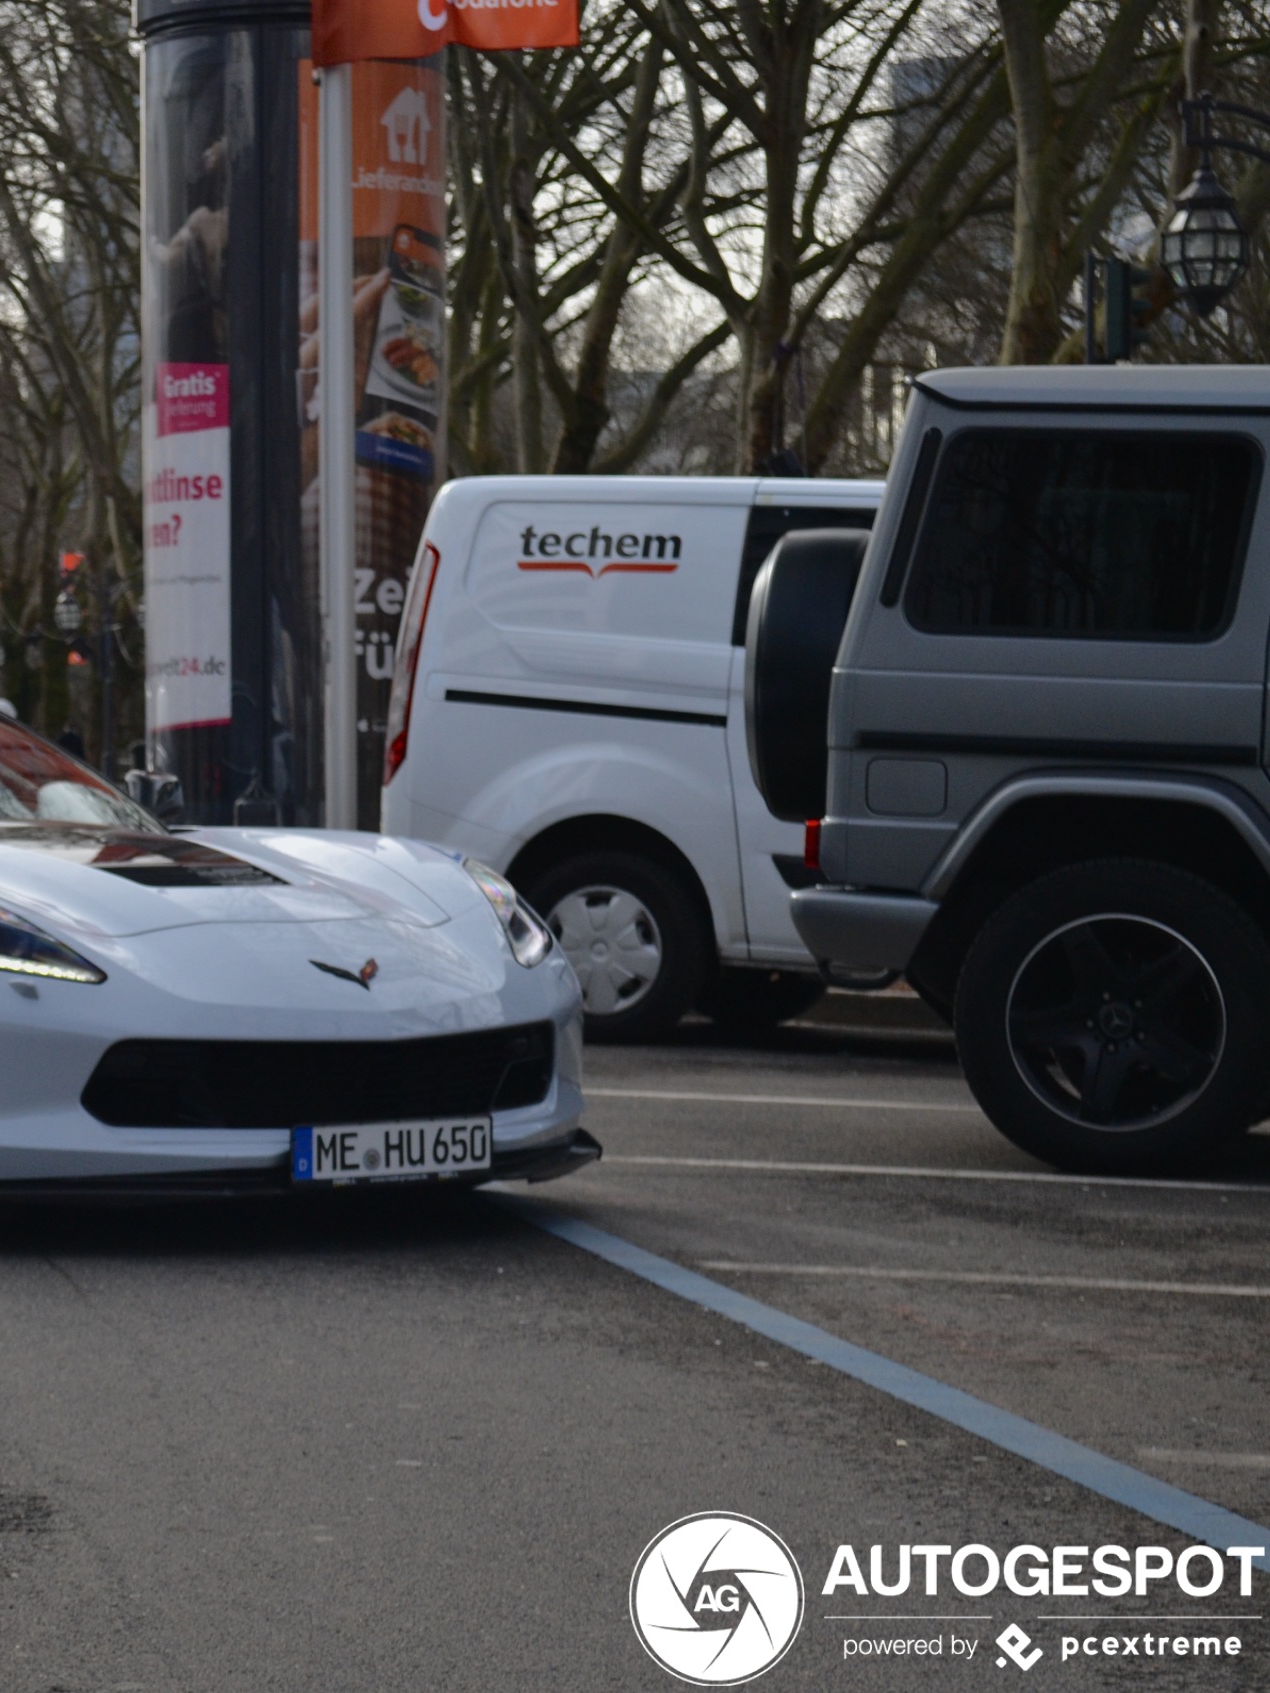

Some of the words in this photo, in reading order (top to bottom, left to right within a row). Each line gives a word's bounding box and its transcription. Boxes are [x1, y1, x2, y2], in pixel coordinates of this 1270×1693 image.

[521, 525, 682, 559] techem
[316, 1132, 359, 1172] ME
[385, 1129, 425, 1168] HU
[433, 1125, 487, 1164] 650
